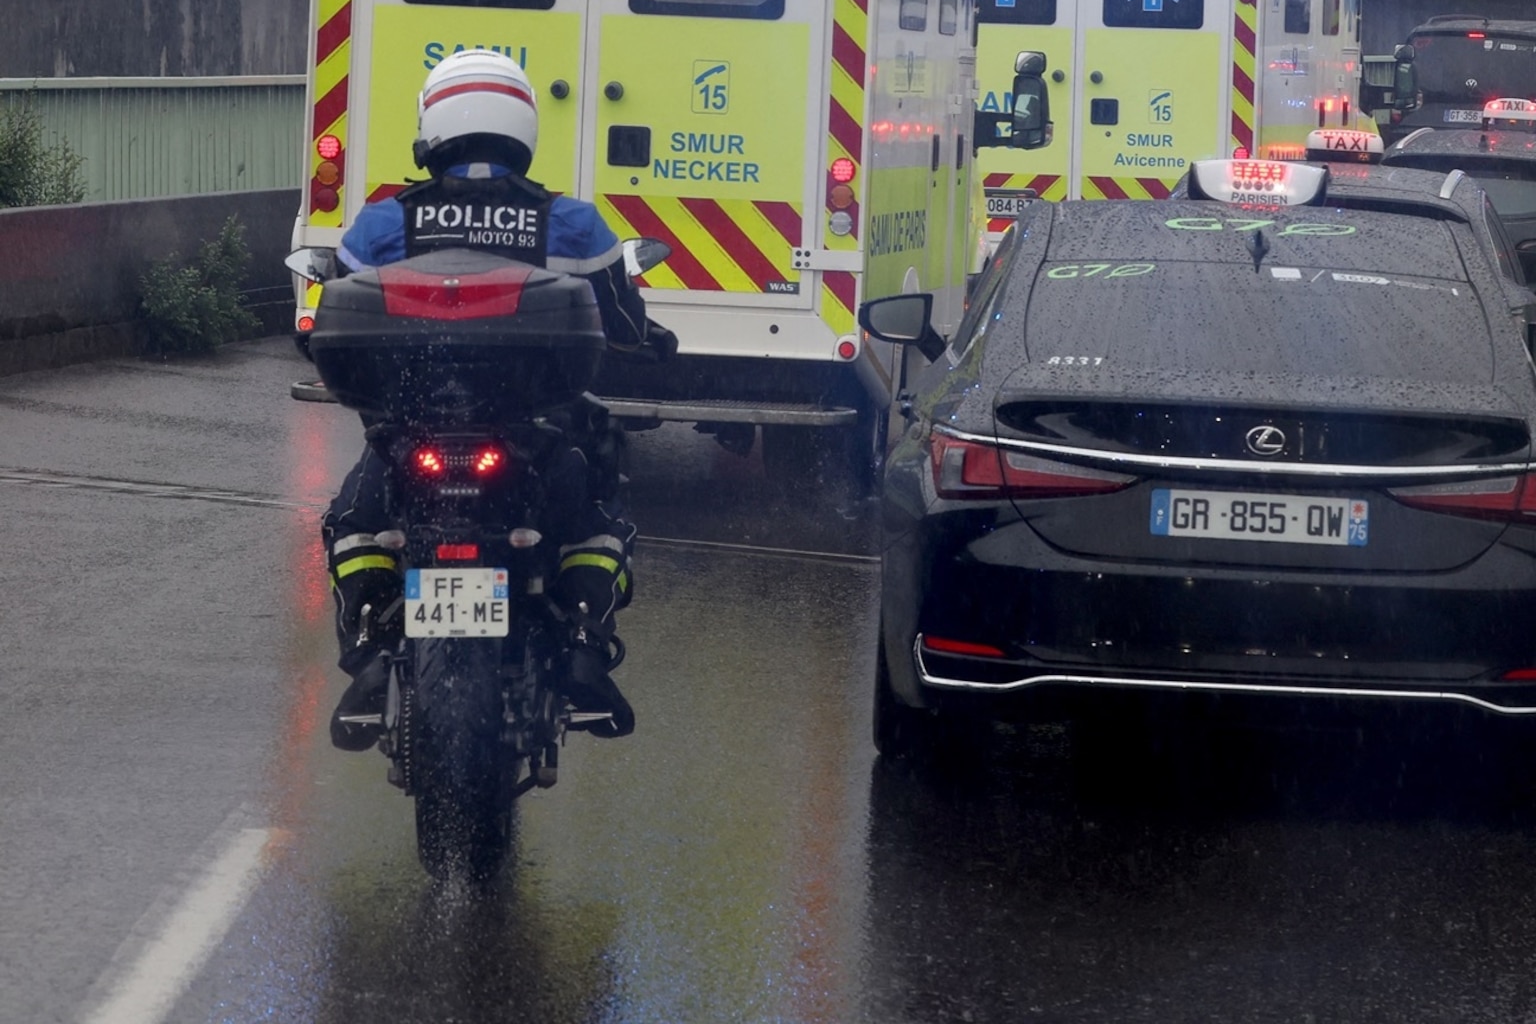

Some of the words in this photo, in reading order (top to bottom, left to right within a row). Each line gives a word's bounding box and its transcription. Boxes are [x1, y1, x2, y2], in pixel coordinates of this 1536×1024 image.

[699, 84, 726, 110] 15
[1501, 100, 1525, 111] TAXI
[1153, 105, 1172, 122] 15
[670, 132, 745, 155] SMUR
[1126, 133, 1173, 148] SMUR
[1323, 135, 1369, 151] TAXI
[1114, 153, 1185, 167] Avicenne
[653, 159, 760, 183] NECKER
[1230, 192, 1288, 205] PARISIEN
[416, 204, 538, 232] POLICE
[468, 230, 514, 246] MOTO
[517, 233, 536, 248] 93
[769, 282, 794, 292] WAS
[1350, 524, 1367, 541] 75
[414, 602, 503, 624] 441-ME
